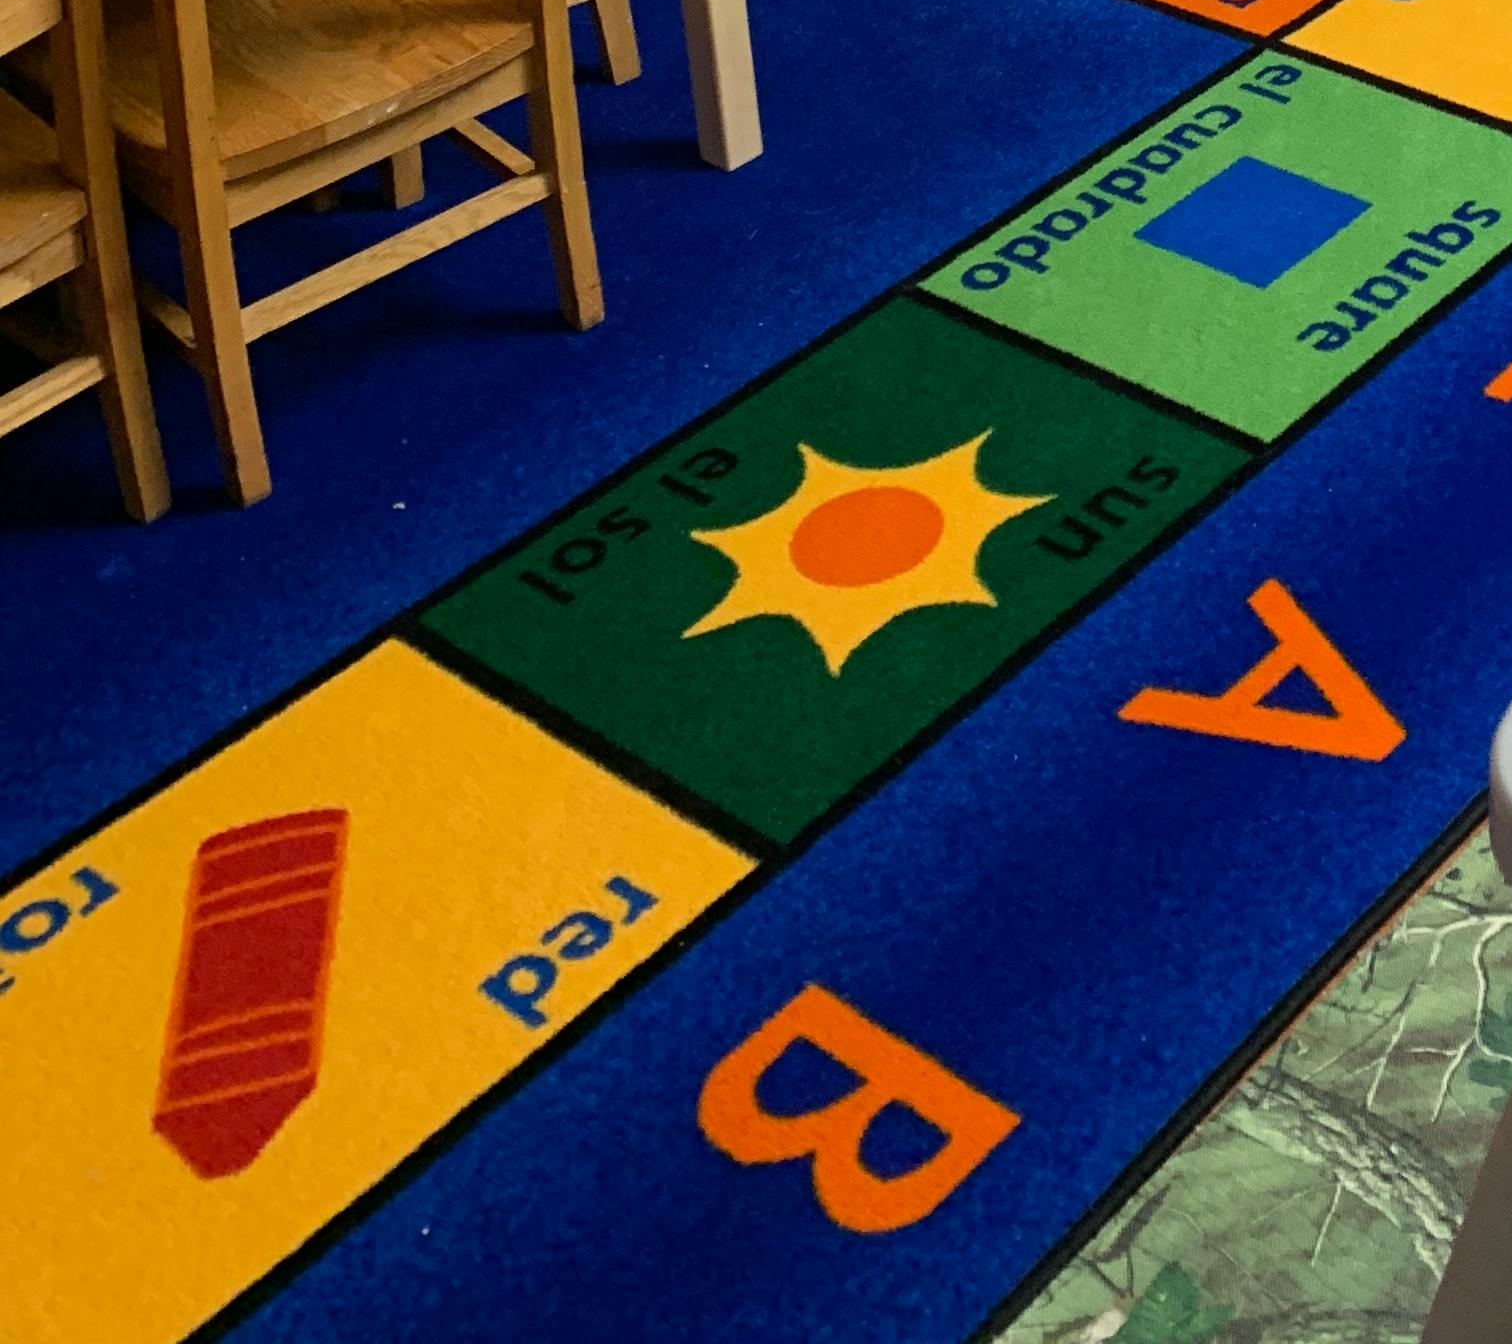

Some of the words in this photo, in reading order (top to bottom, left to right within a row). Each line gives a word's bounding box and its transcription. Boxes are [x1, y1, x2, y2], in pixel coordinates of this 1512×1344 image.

[1240, 63, 1303, 105] el
[960, 102, 1243, 293] cuadrado
[1296, 199, 1503, 353] square
[659, 446, 740, 507] el
[1032, 453, 1183, 564] sun
[516, 504, 652, 606] sol
[1116, 577, 1407, 764] A
[478, 871, 661, 1031] red
[698, 980, 1023, 1235] B
